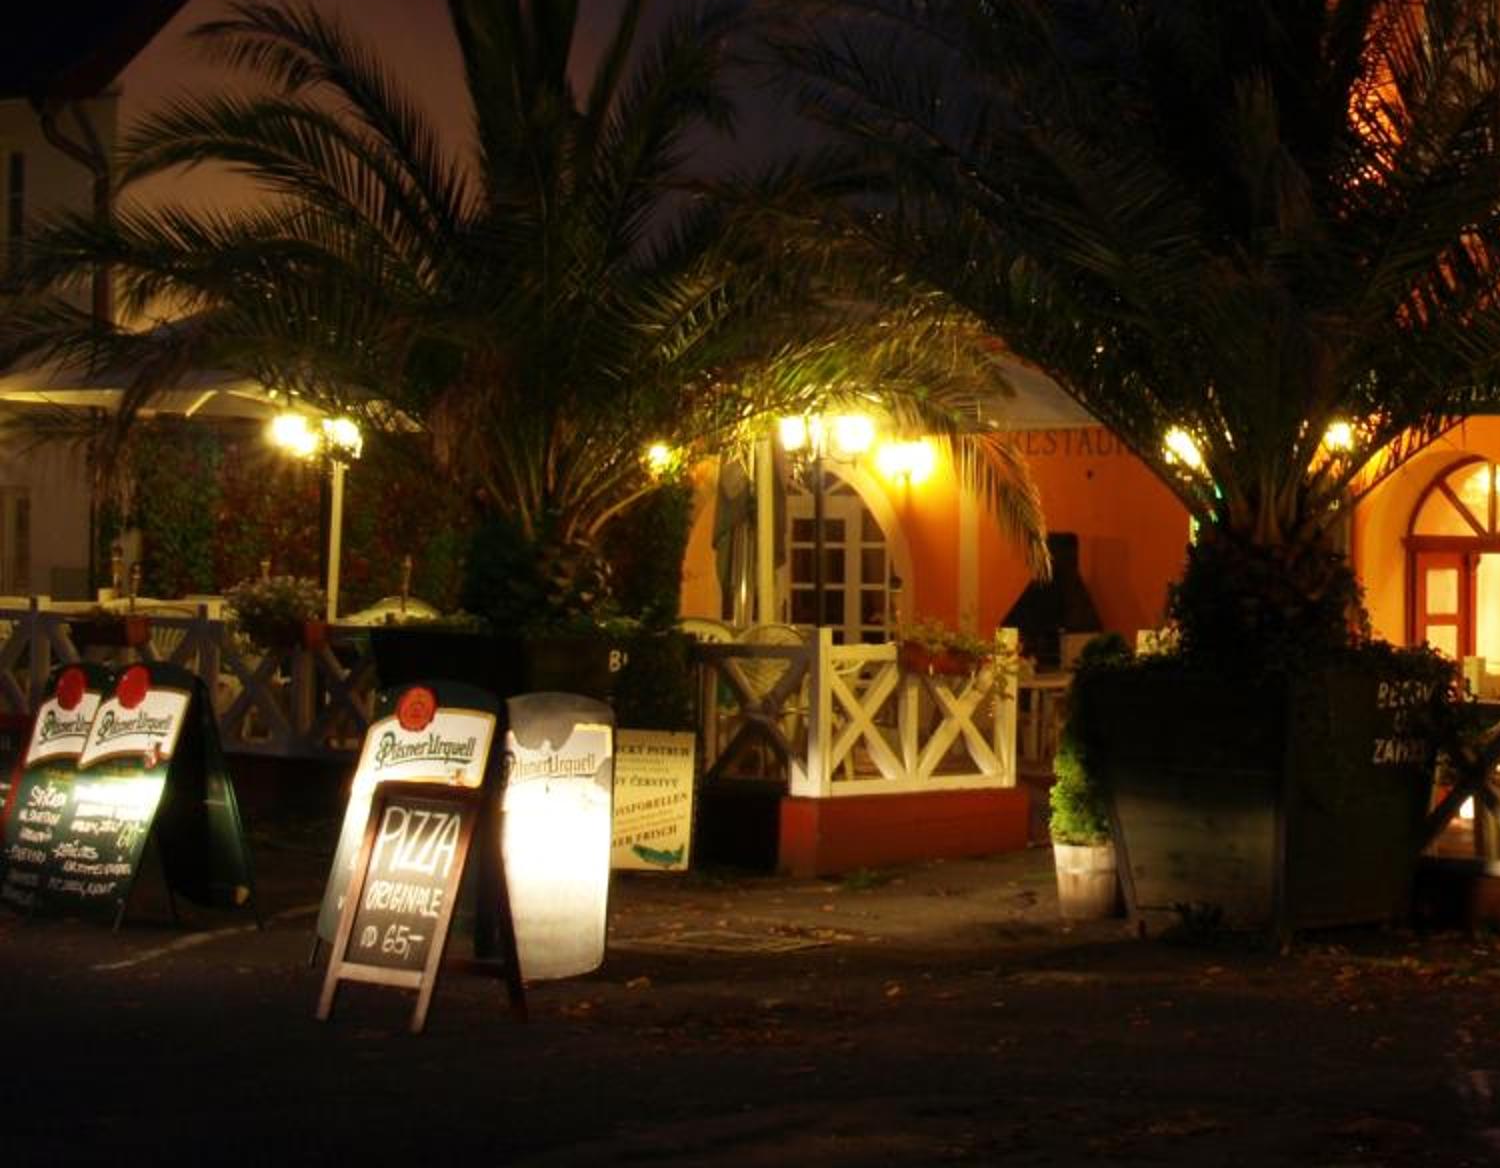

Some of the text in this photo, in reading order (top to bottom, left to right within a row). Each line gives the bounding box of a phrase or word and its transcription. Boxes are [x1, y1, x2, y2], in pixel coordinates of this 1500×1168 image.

[138, 710, 173, 734] Urquell
[374, 731, 478, 770] Pilsner Urquell
[368, 804, 464, 880] PIZZA
[364, 879, 444, 918] ORIGINALE
